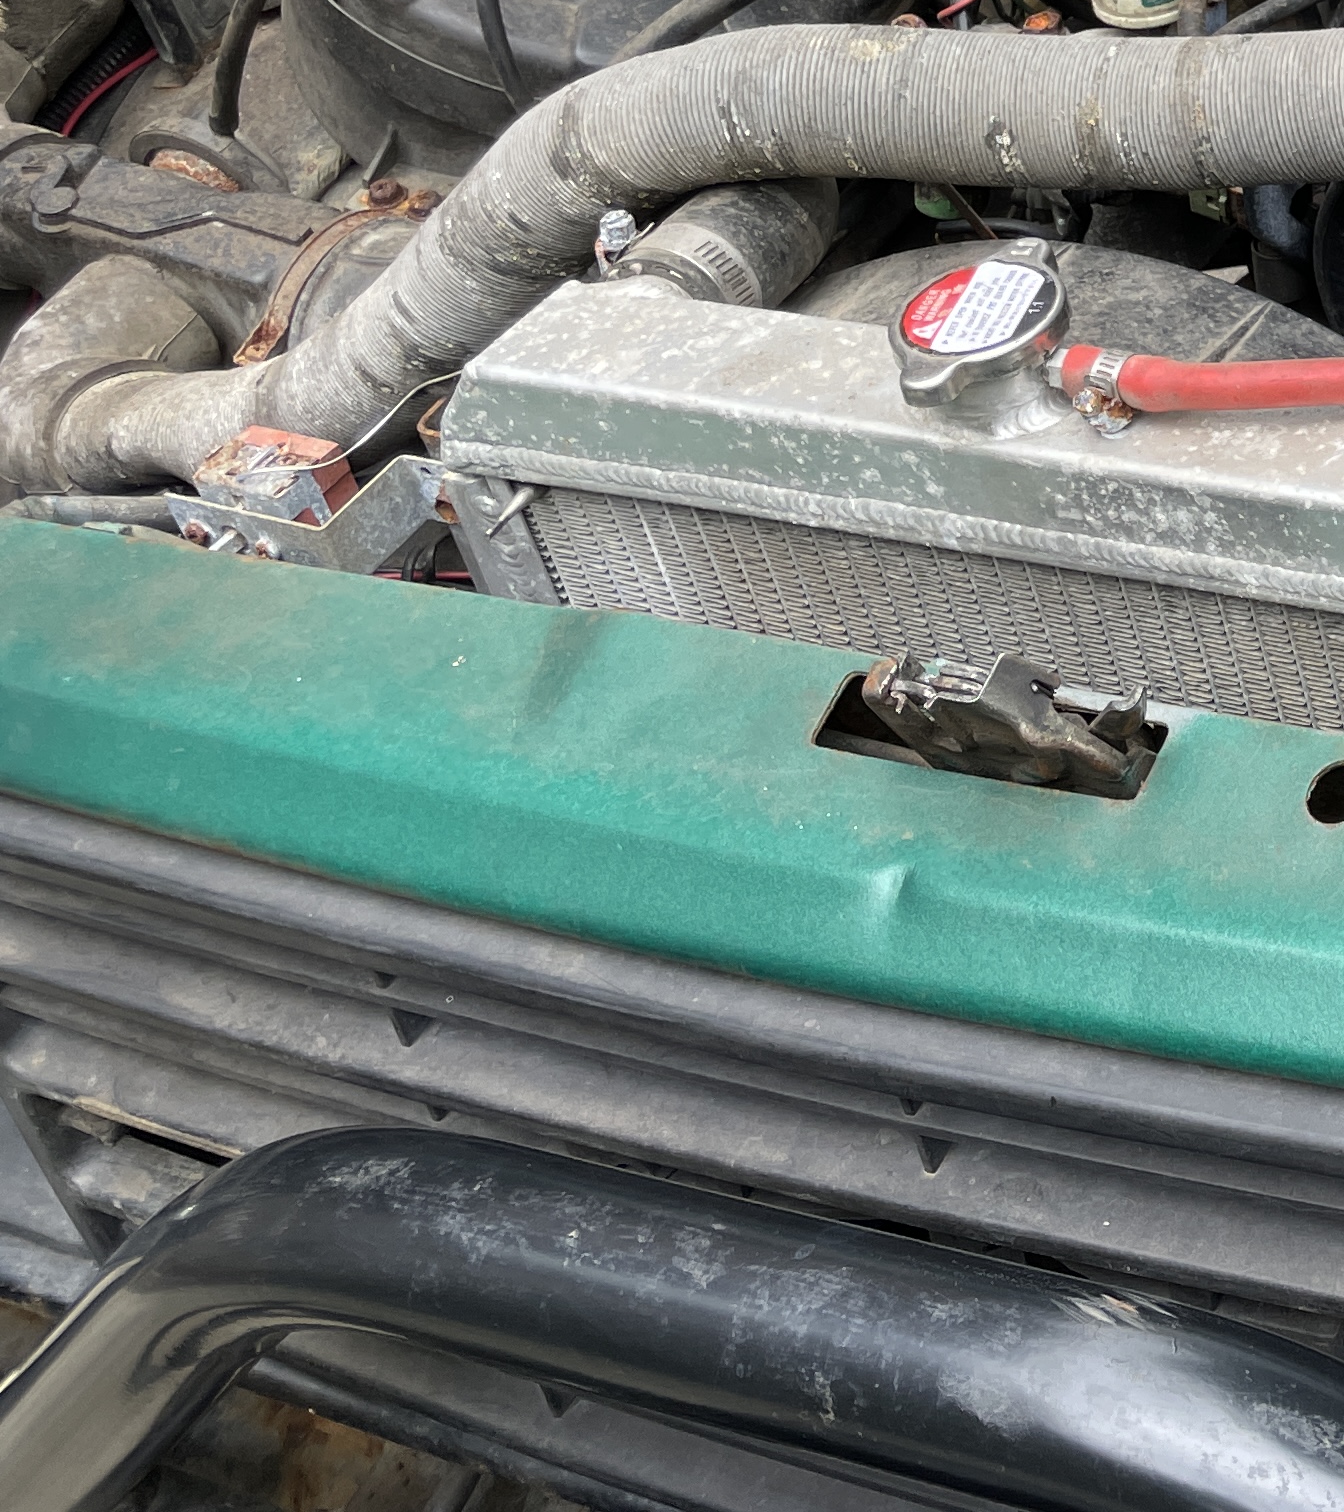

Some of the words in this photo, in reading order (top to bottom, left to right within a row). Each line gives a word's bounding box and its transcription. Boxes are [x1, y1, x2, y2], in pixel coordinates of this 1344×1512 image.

[911, 289, 941, 321] DANGER
[923, 288, 953, 322] WARNING
[1028, 301, 1045, 315] 1.1
